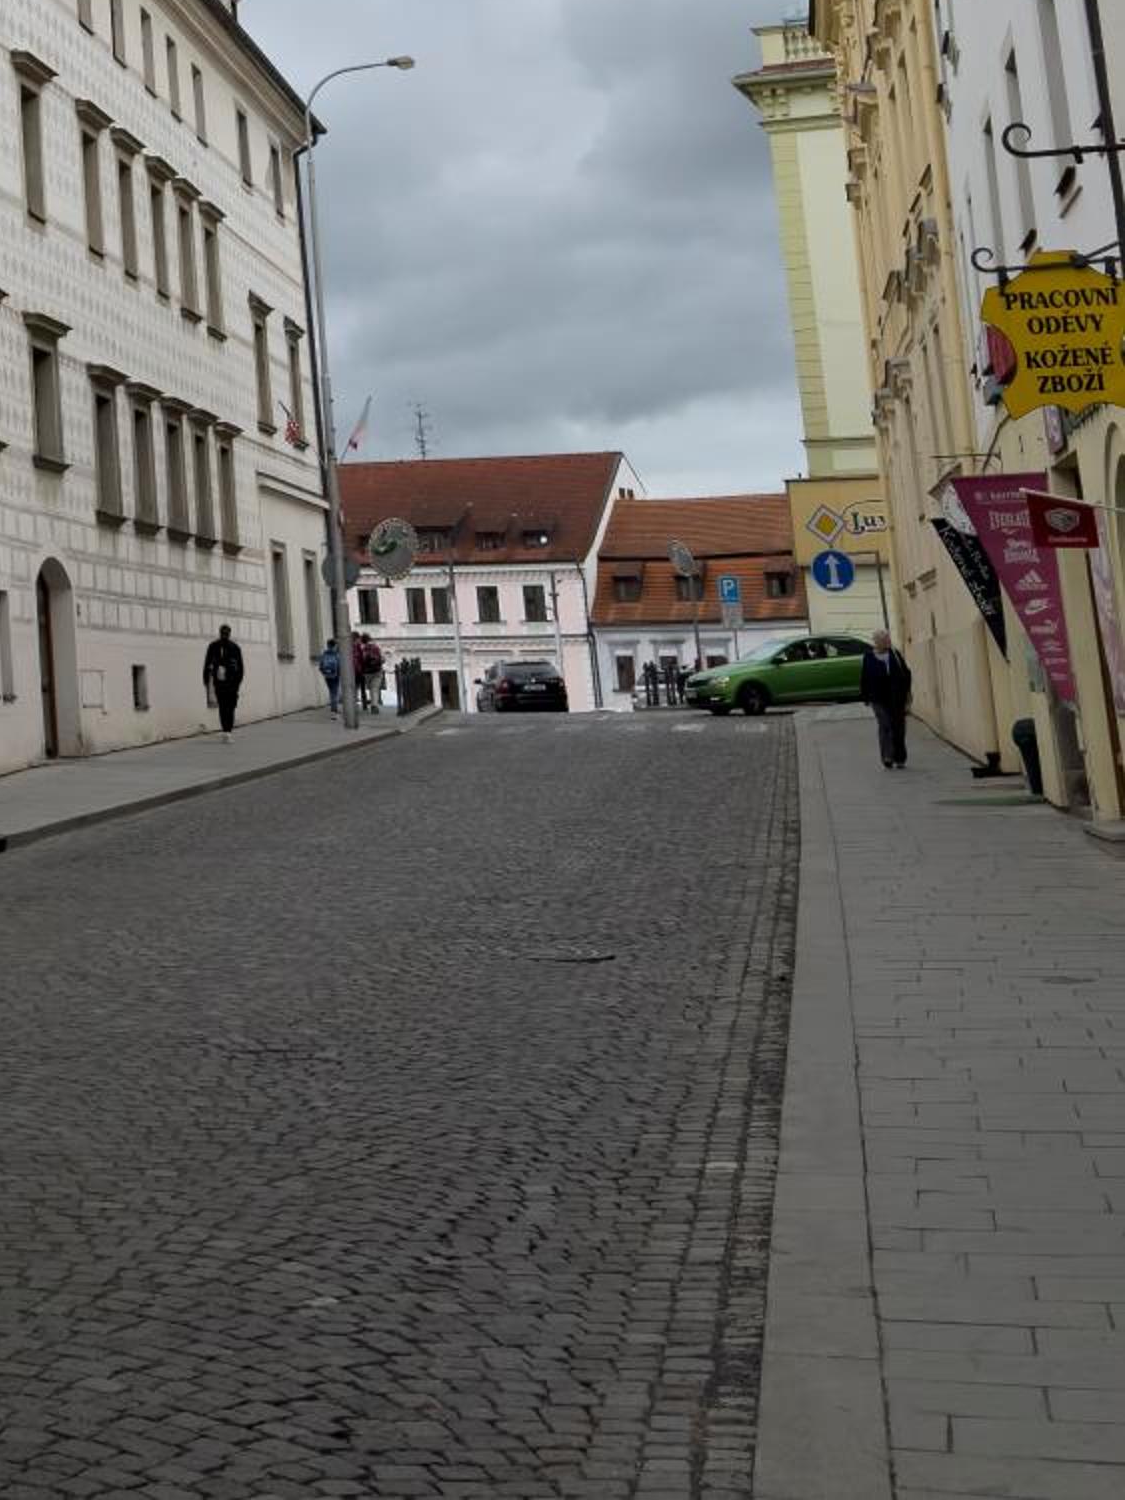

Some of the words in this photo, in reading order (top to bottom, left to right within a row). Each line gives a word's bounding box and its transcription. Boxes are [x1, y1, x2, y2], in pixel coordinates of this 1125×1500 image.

[1027, 310, 1104, 335] ODĚVY
[1025, 342, 1115, 369] KOŽENÉ
[1037, 368, 1105, 394] ZBOŽÍ
